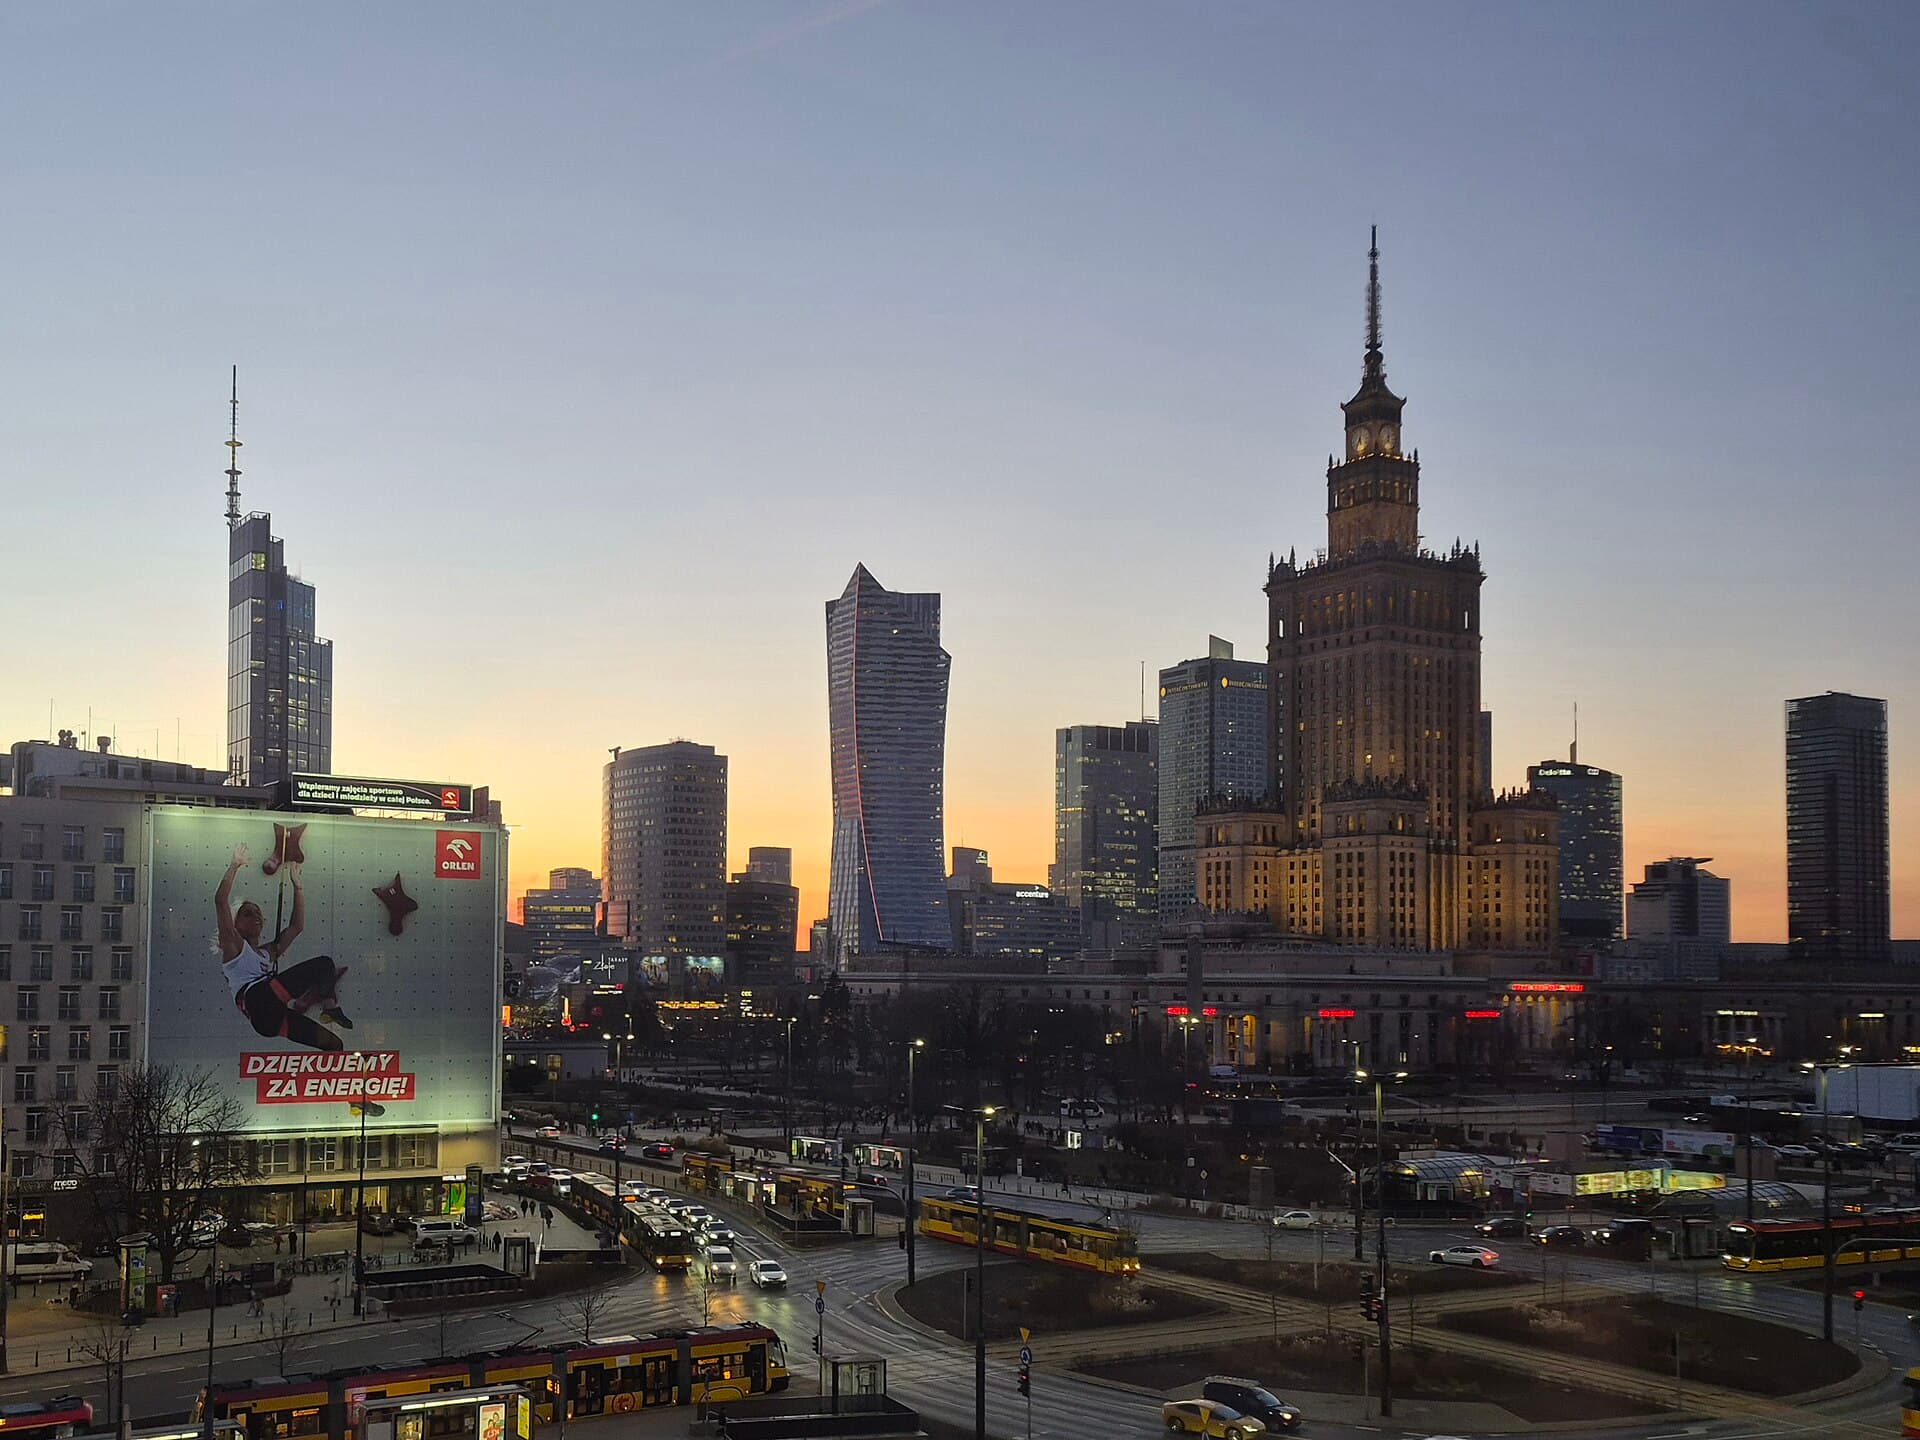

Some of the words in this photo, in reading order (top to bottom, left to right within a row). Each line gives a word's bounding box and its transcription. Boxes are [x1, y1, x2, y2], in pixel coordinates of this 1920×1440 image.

[298, 790, 311, 798] dla
[312, 791, 334, 799] dzieci
[442, 861, 474, 870] ORLEN
[1016, 890, 1049, 898] accenture
[247, 1054, 394, 1077] DZIĘKUJEMY
[266, 1079, 298, 1097] ZA
[304, 1077, 408, 1098] ENERGIĘ!
